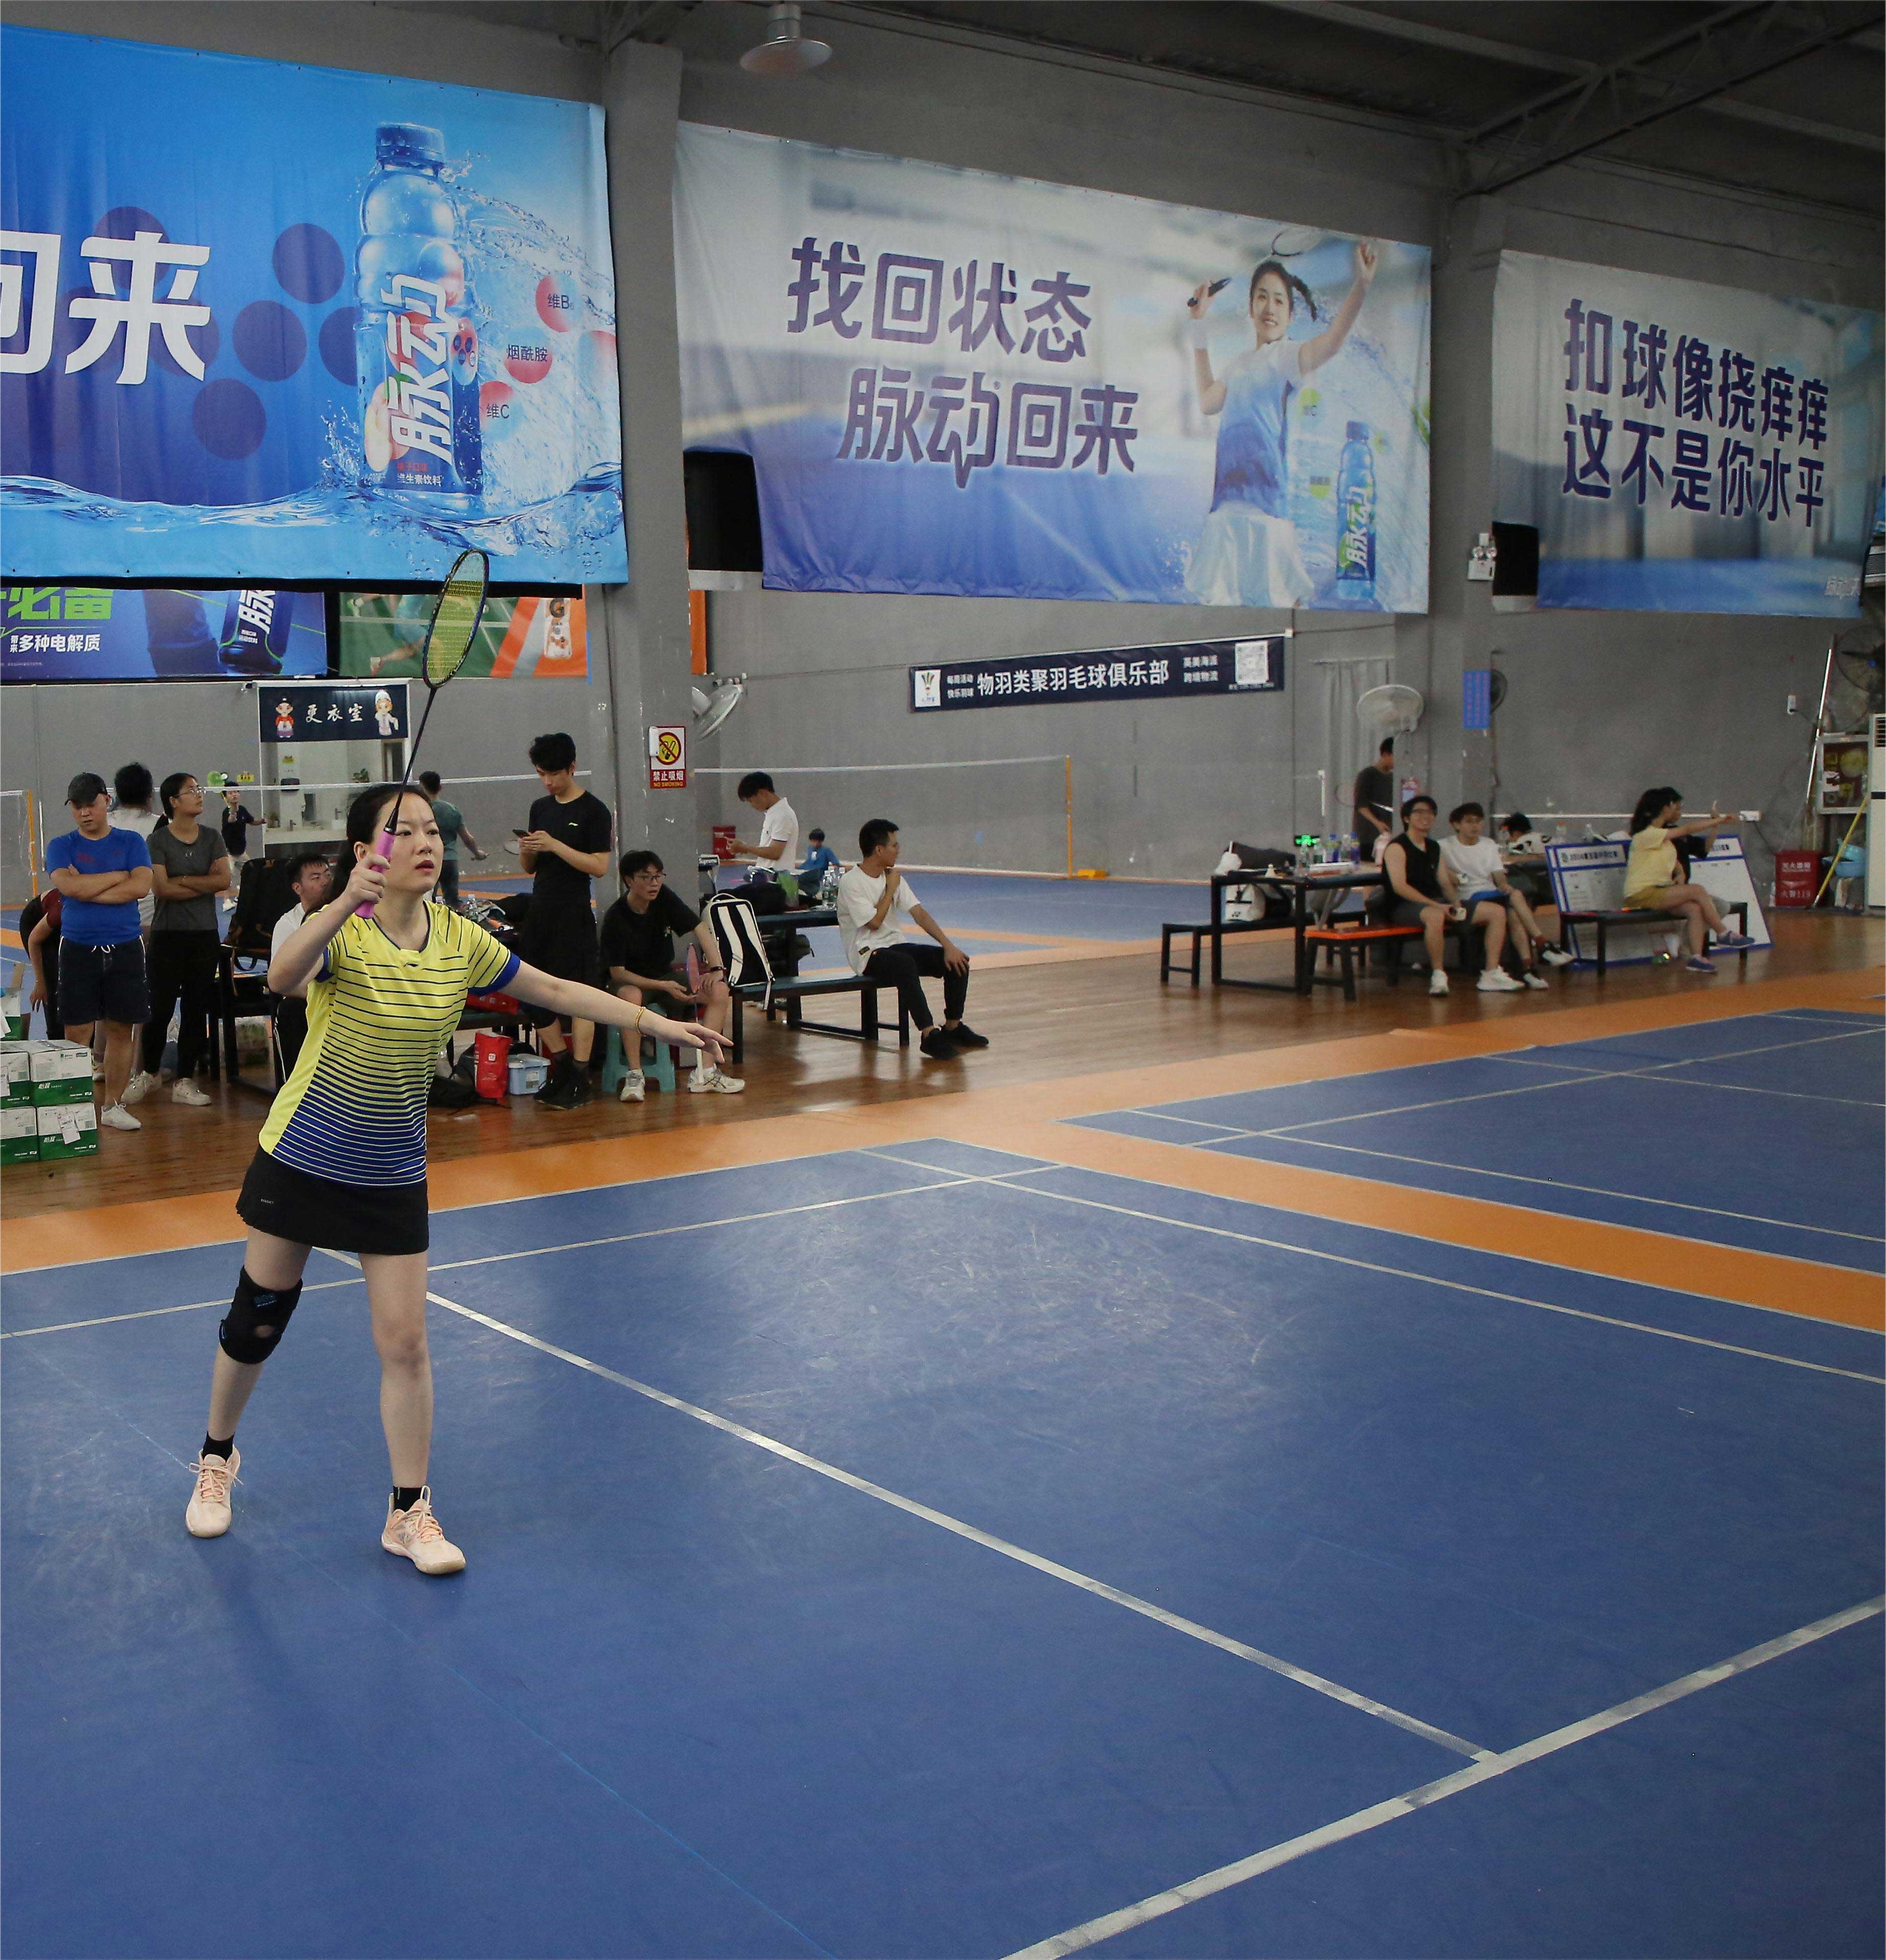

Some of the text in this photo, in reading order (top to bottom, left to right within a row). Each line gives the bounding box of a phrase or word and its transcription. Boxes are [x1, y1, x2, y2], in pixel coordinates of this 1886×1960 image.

[788, 237, 1091, 362] 找回状态
[507, 345, 548, 362] 烟酰胺
[380, 274, 458, 465] 脉动
[1563, 299, 1828, 450] 扣球像挠痒痒
[486, 403, 509, 419] 维C
[837, 365, 1138, 488] 脉动回来
[397, 473, 442, 486] 维生素饮料
[1563, 403, 1824, 527] 这不是你水平
[19, 634, 101, 652] 多种电解质
[977, 659, 1169, 696] 物羽类聚羽毛球俱乐部
[306, 703, 364, 724] 更衣室
[653, 771, 684, 781] 禁止吸烟
